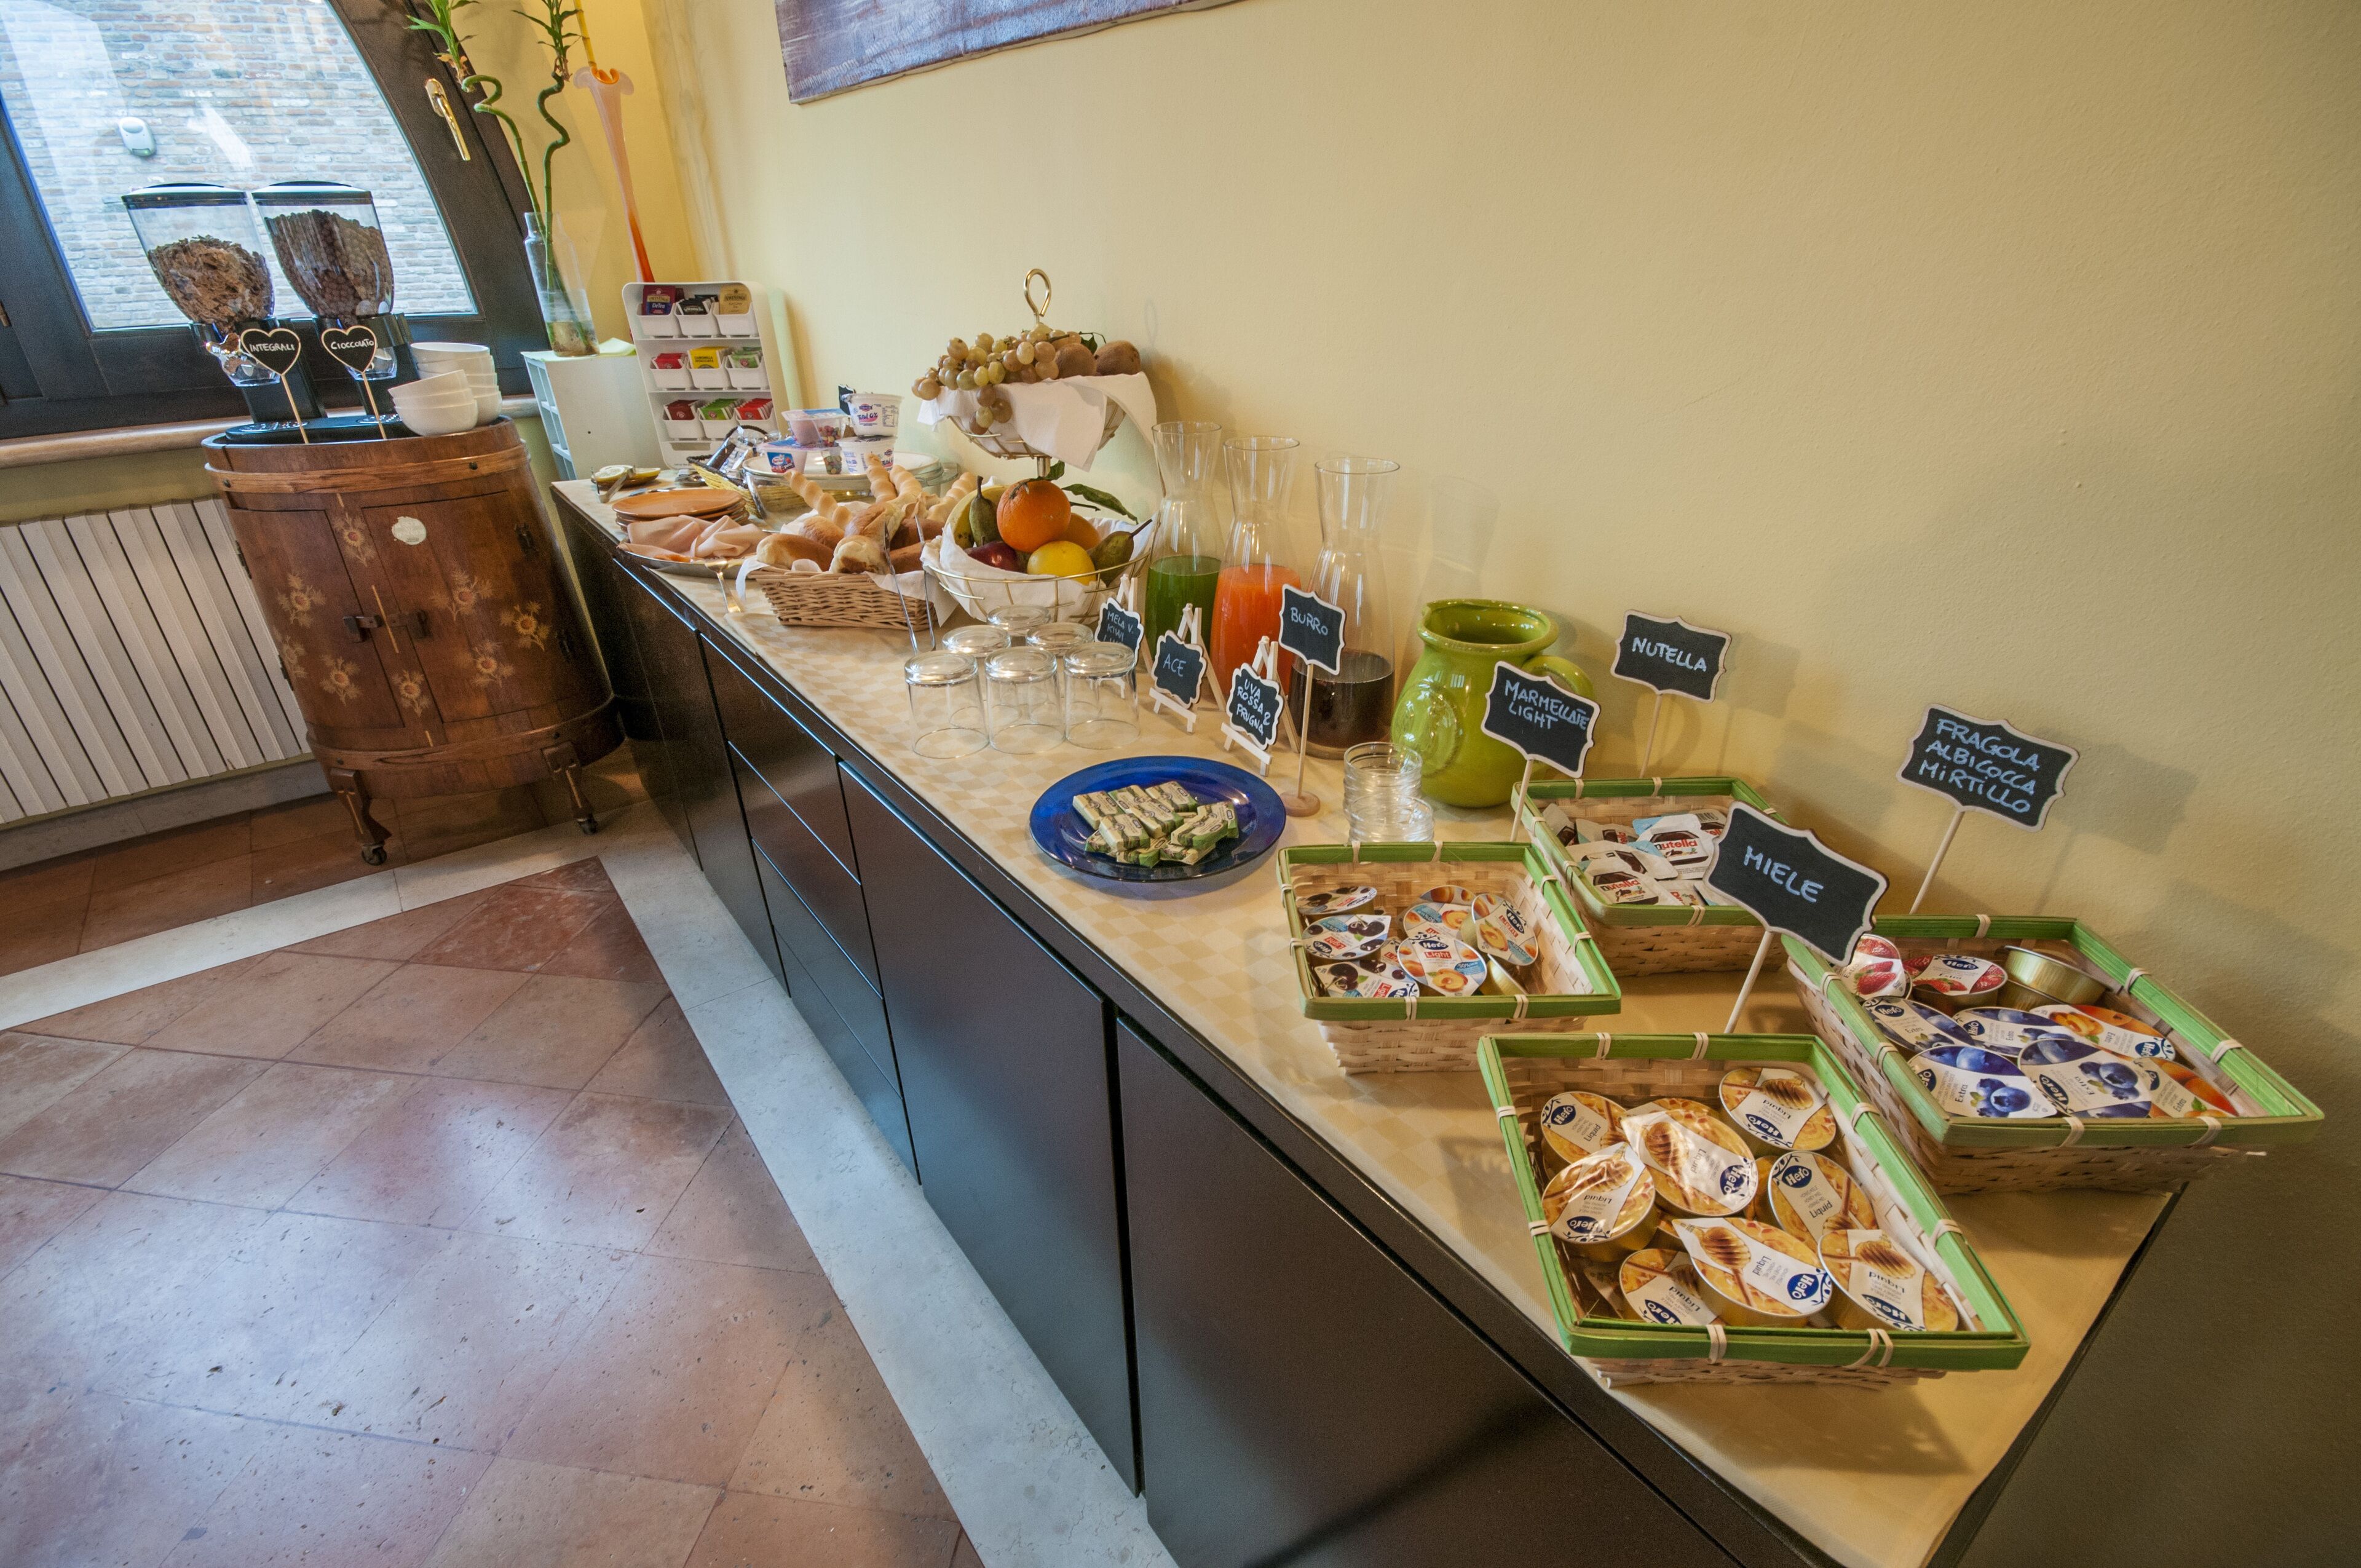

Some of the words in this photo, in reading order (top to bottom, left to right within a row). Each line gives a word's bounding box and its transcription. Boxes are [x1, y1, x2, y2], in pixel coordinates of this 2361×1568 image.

[249, 343, 295, 352] INTEGRALI
[1107, 611, 1125, 629] MELA
[1291, 607, 1329, 636] BURRO
[1107, 624, 1125, 641] KIWI
[1163, 653, 1187, 677] ACE
[1631, 636, 1707, 673] NUTELLA
[1237, 686, 1264, 715] ROSSA
[1244, 679, 1260, 700] UVA
[1504, 679, 1590, 731] MARMELLATE
[1508, 700, 1559, 730] LIGHT
[1236, 703, 1264, 736] PRUGNA
[1936, 718, 2040, 772] FRAGOLA
[1925, 740, 2037, 796] ALBICOCCA
[1654, 839, 1698, 850] nutella
[1743, 845, 1824, 903] MIELE
[1600, 879, 1641, 892] nutella
[1507, 912, 1524, 932] Hero
[1947, 960, 1977, 969] Hero
[1955, 1084, 1968, 1103] Extra
[2041, 1077, 2067, 1103] Hero
[1554, 1106, 1573, 1125] Hero
[1762, 1099, 1791, 1120] Liquid
[1583, 1123, 1601, 1142] Liquid
[1748, 1115, 1779, 1137] Hero
[1691, 1148, 1707, 1173] Liquid
[1723, 1166, 1741, 1195] Hero
[1785, 1168, 1809, 1186] Hero
[1584, 1195, 1613, 1205] Liquid
[1809, 1200, 1833, 1219] Liquid
[1752, 1256, 1771, 1277] Liquid
[1792, 1274, 1815, 1299] Hero
[1869, 1271, 1905, 1294] Liquid
[1669, 1286, 1701, 1312] Liquid
[1866, 1297, 1906, 1321] Hero
